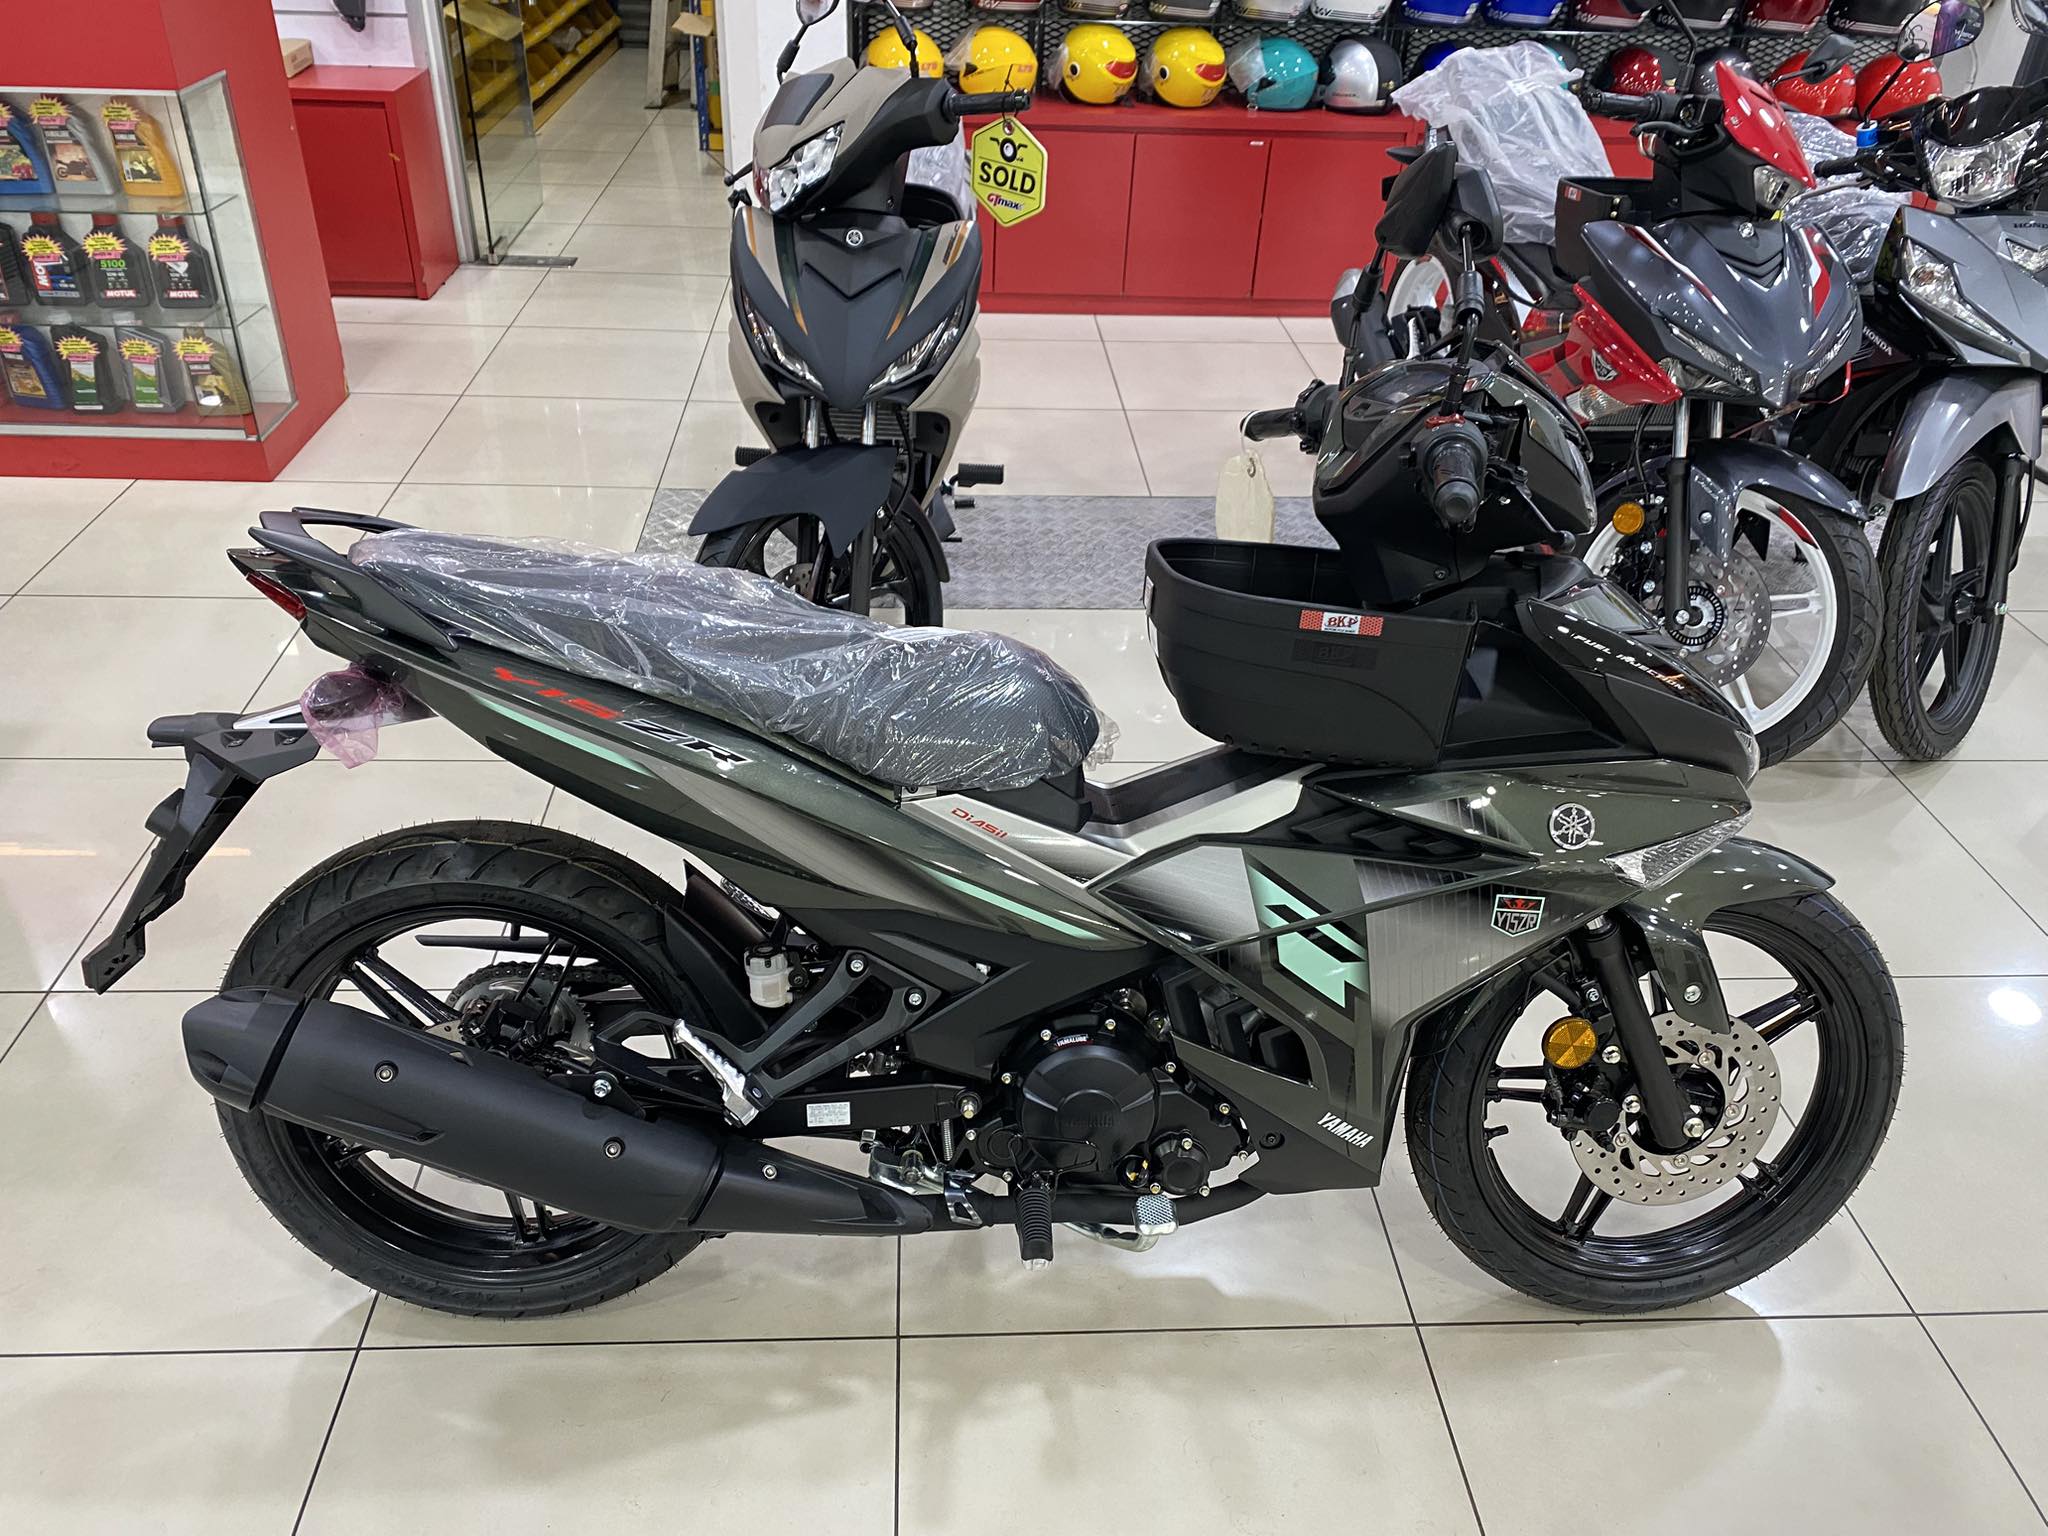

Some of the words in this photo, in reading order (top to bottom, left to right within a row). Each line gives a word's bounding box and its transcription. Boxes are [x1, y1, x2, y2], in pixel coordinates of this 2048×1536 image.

[978, 160, 1036, 194] SOLD
[100, 259, 126, 268] 5100
[105, 290, 136, 298] MOTUL
[168, 290, 199, 298] MOTUL
[1862, 325, 1892, 357] HONDA
[1327, 615, 1359, 628] BKP
[1571, 634, 1612, 655] FUEL
[1496, 911, 1538, 934] Y15ZR
[1317, 1111, 1374, 1148] YAMAHA
